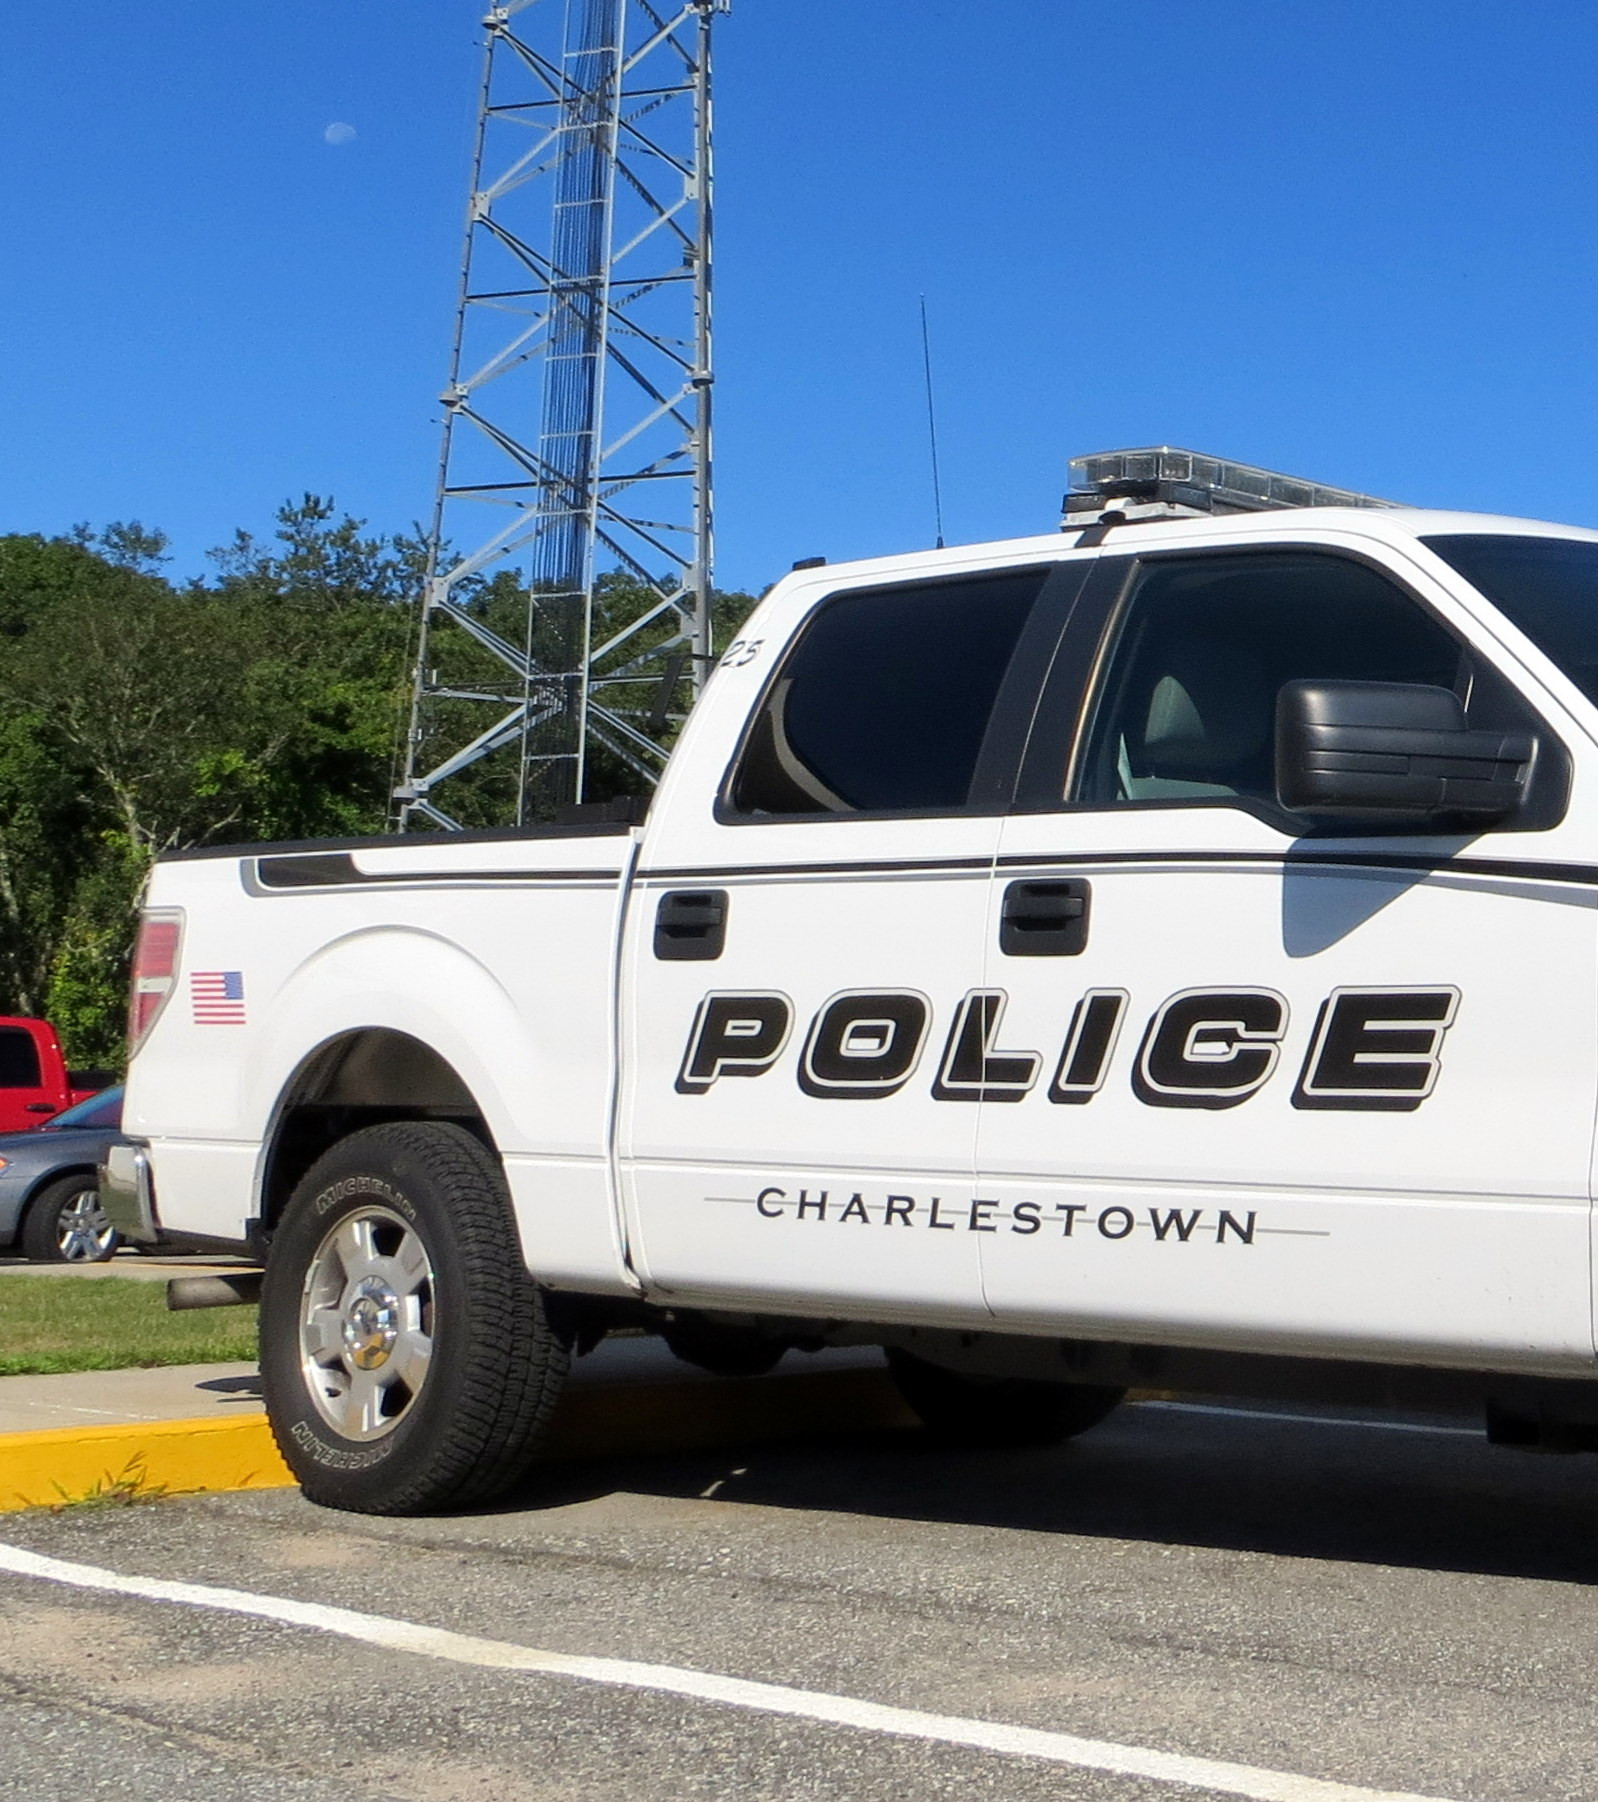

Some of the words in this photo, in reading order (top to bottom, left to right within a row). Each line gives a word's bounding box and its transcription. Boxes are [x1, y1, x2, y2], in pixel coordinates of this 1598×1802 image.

[720, 639, 765, 668] 25
[674, 985, 1463, 1111] POLICE
[316, 1176, 416, 1221] MICHELIN
[755, 1186, 1258, 1245] CHARLESTOWN
